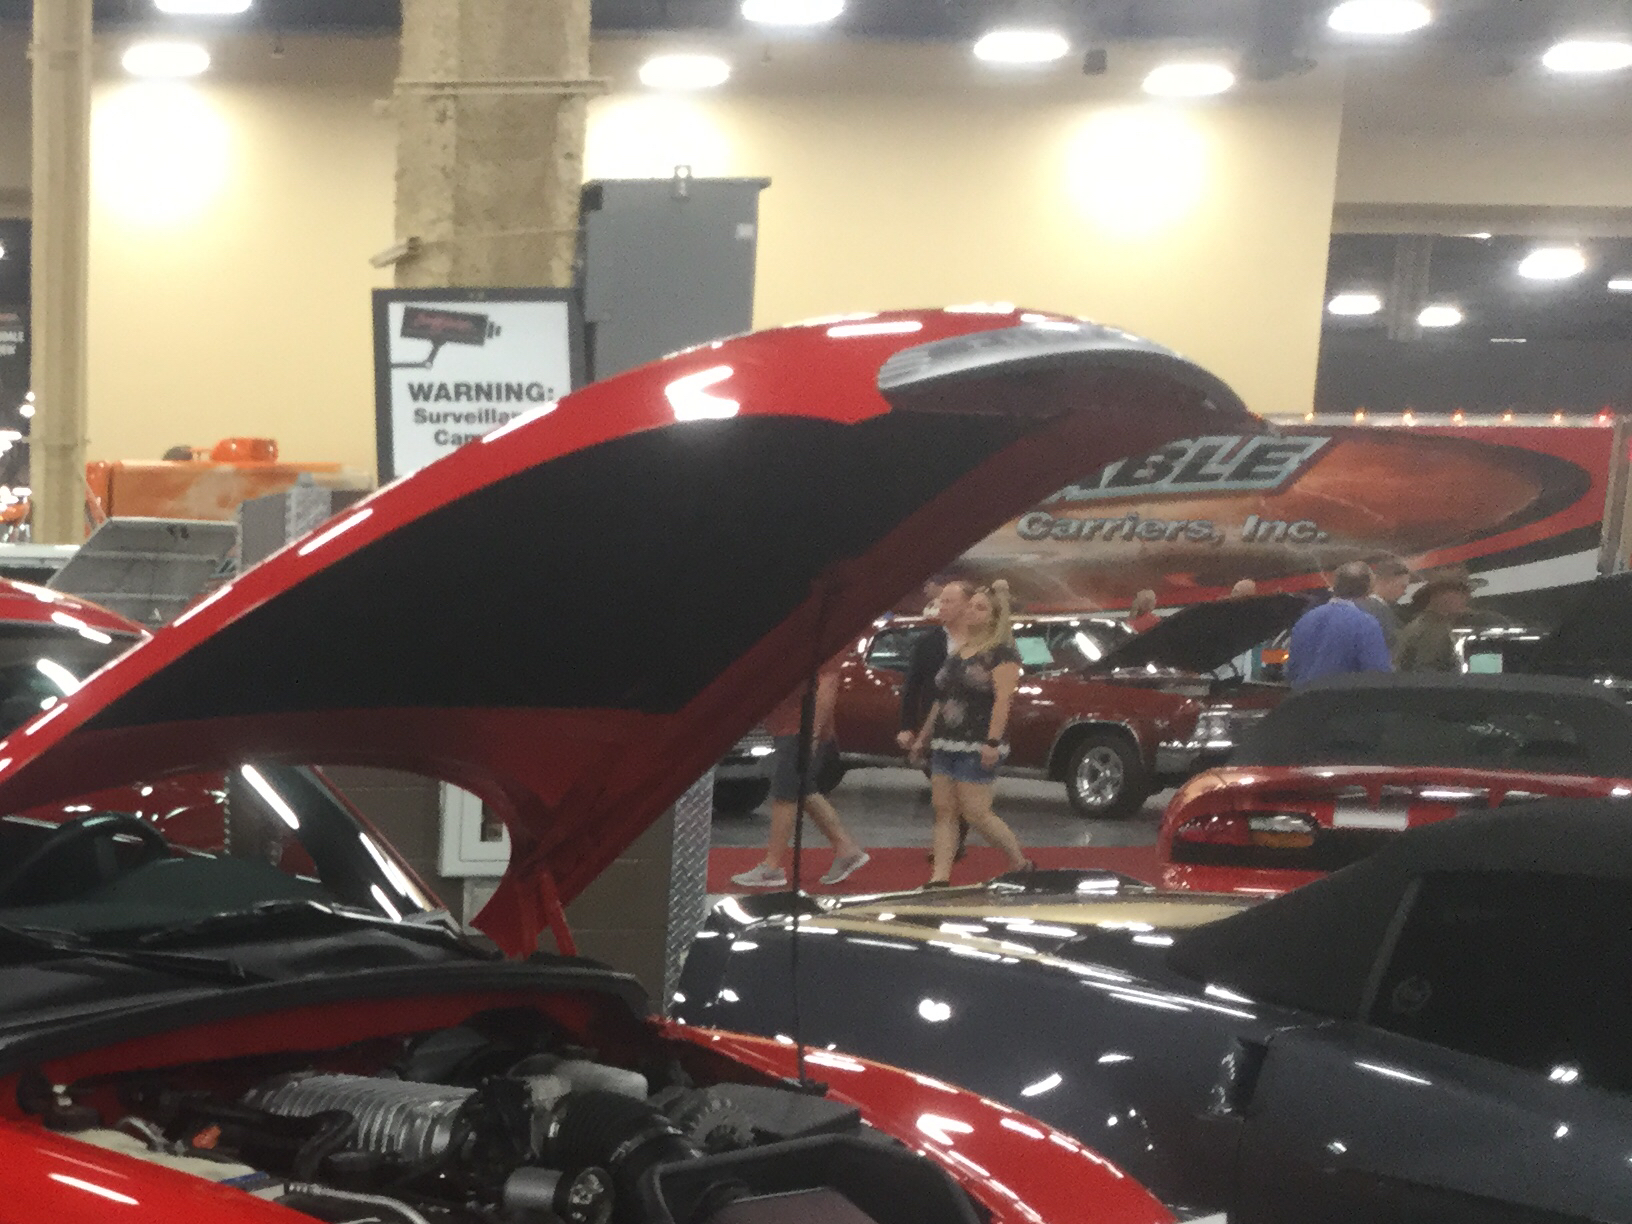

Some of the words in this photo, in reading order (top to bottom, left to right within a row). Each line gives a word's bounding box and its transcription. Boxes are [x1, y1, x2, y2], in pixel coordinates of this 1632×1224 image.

[408, 382, 555, 402] WARNING:
[414, 407, 522, 425] Surveilla
[1041, 436, 1332, 503] BLE
[1016, 511, 1226, 543] Carriers,
[1240, 514, 1329, 544] Inc.
